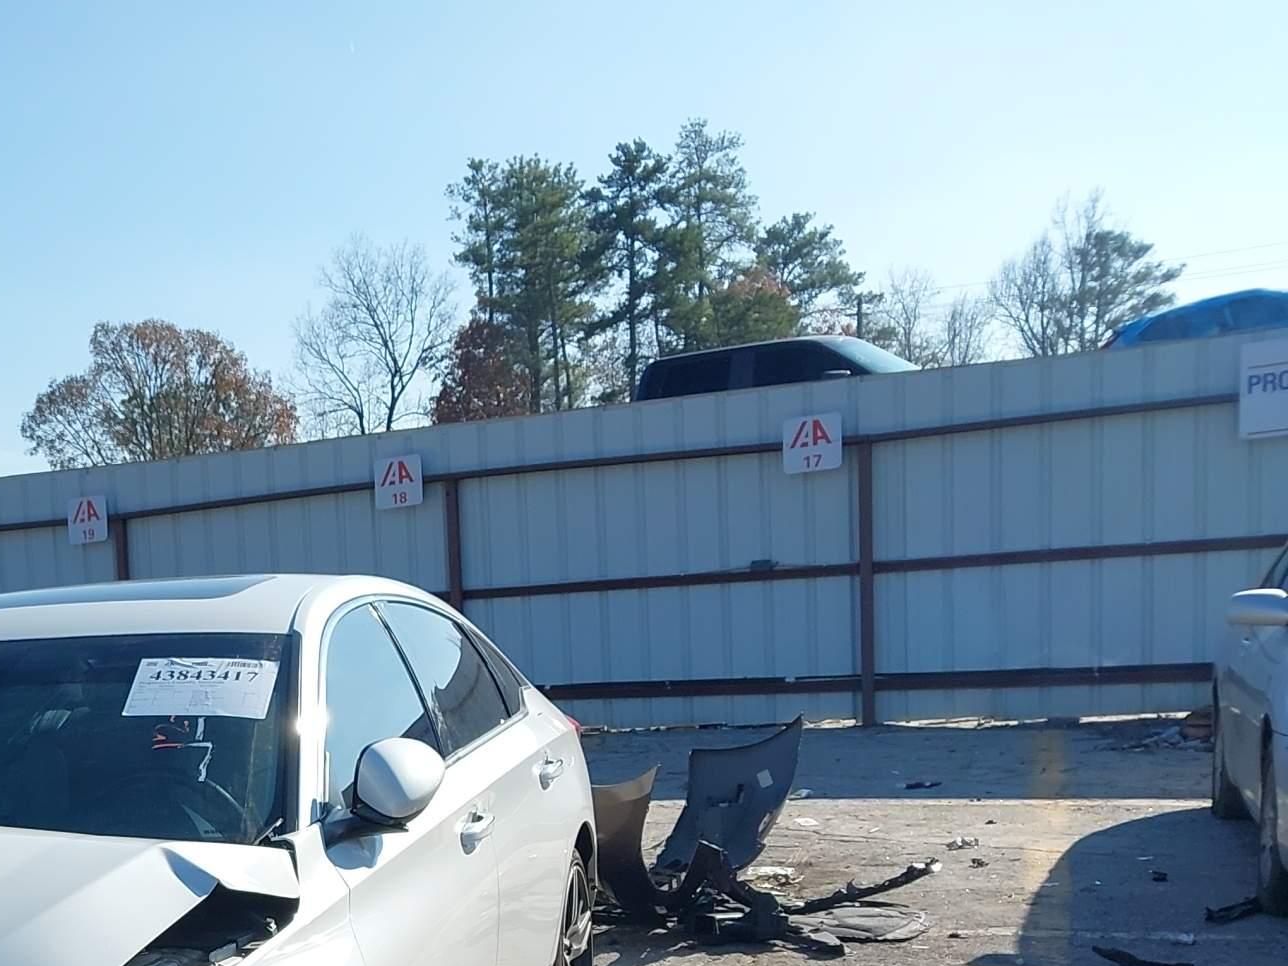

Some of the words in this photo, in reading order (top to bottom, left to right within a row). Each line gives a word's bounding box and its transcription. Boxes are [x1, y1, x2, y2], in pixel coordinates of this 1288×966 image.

[803, 454, 822, 468] 17
[392, 491, 407, 505] 18
[82, 528, 95, 541] 19
[149, 669, 259, 682] 43843417
